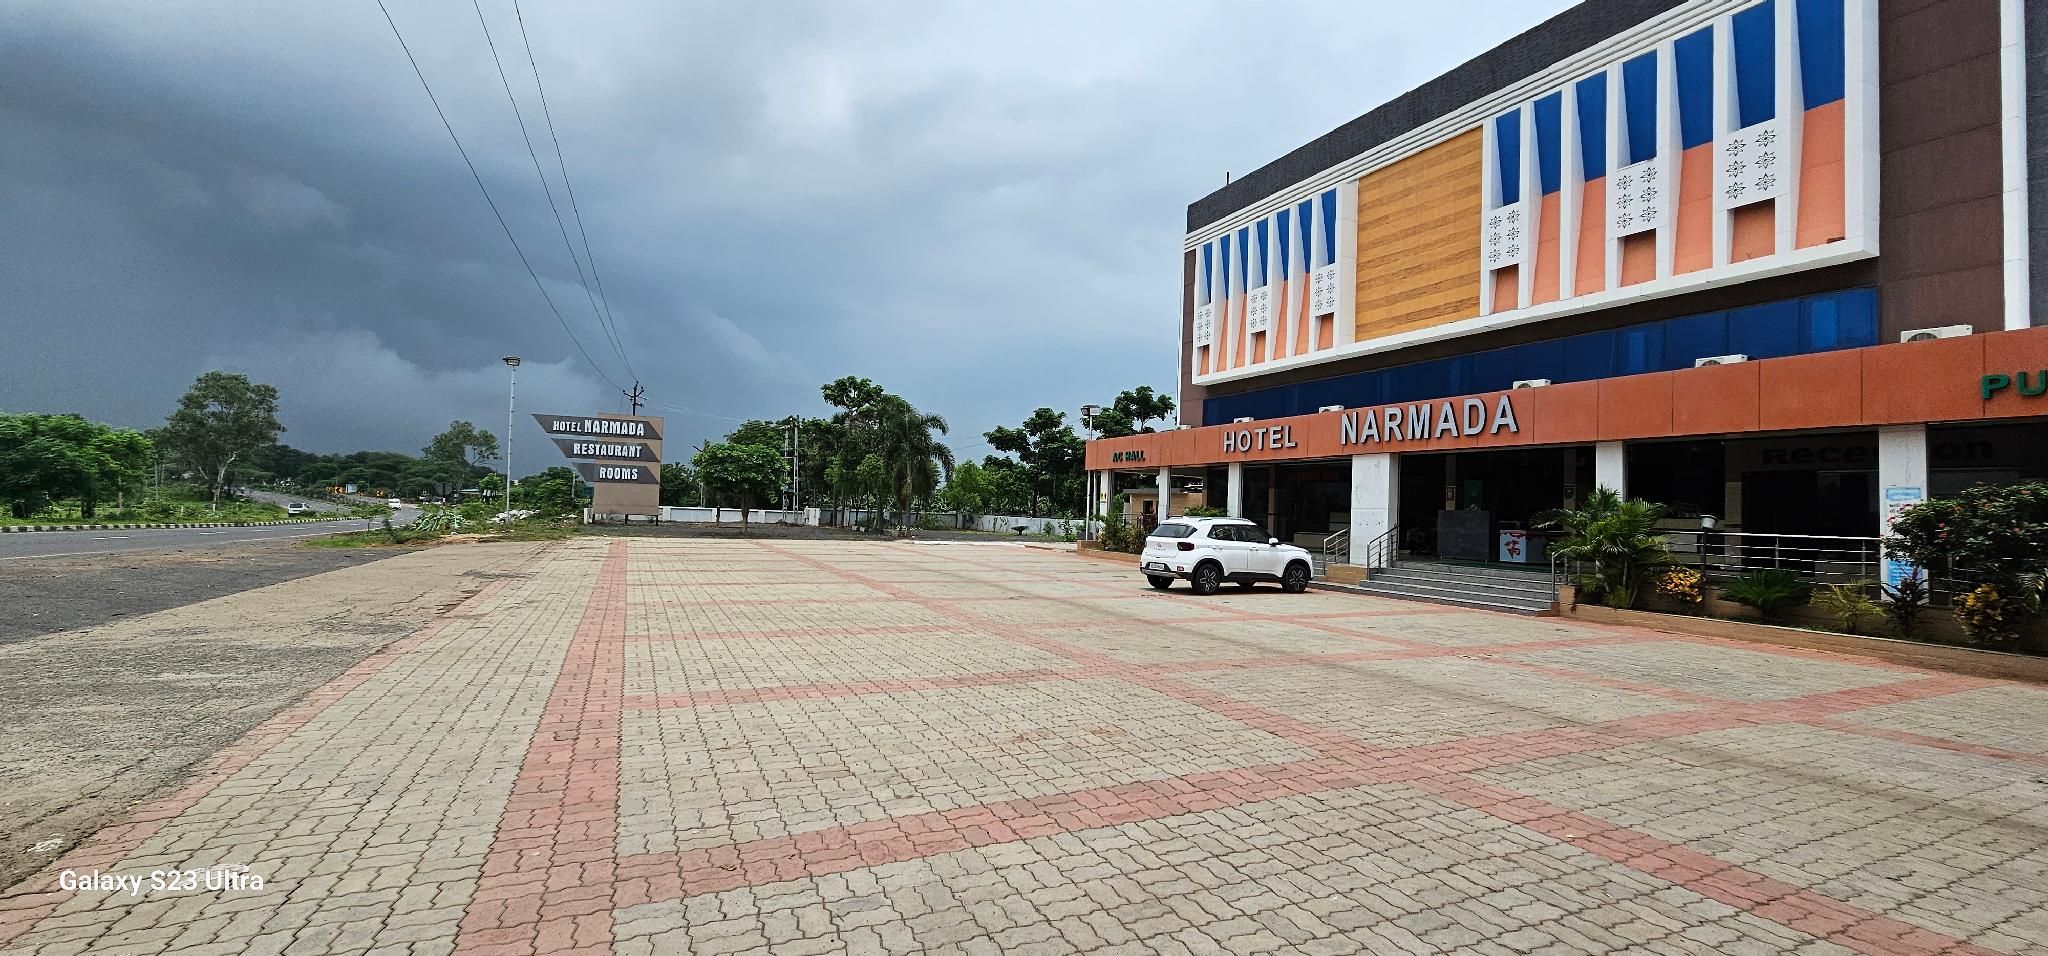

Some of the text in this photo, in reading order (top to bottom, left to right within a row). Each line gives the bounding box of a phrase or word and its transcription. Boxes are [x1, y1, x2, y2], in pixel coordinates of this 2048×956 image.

[553, 420, 644, 436] HOTEL NARMADA
[1223, 394, 1519, 453] HOTEL NARMADA
[573, 443, 641, 457] RESTAURANT
[1112, 450, 1145, 463] AC HALL
[1762, 440, 1994, 465] Receon
[599, 467, 639, 480] ROOMS
